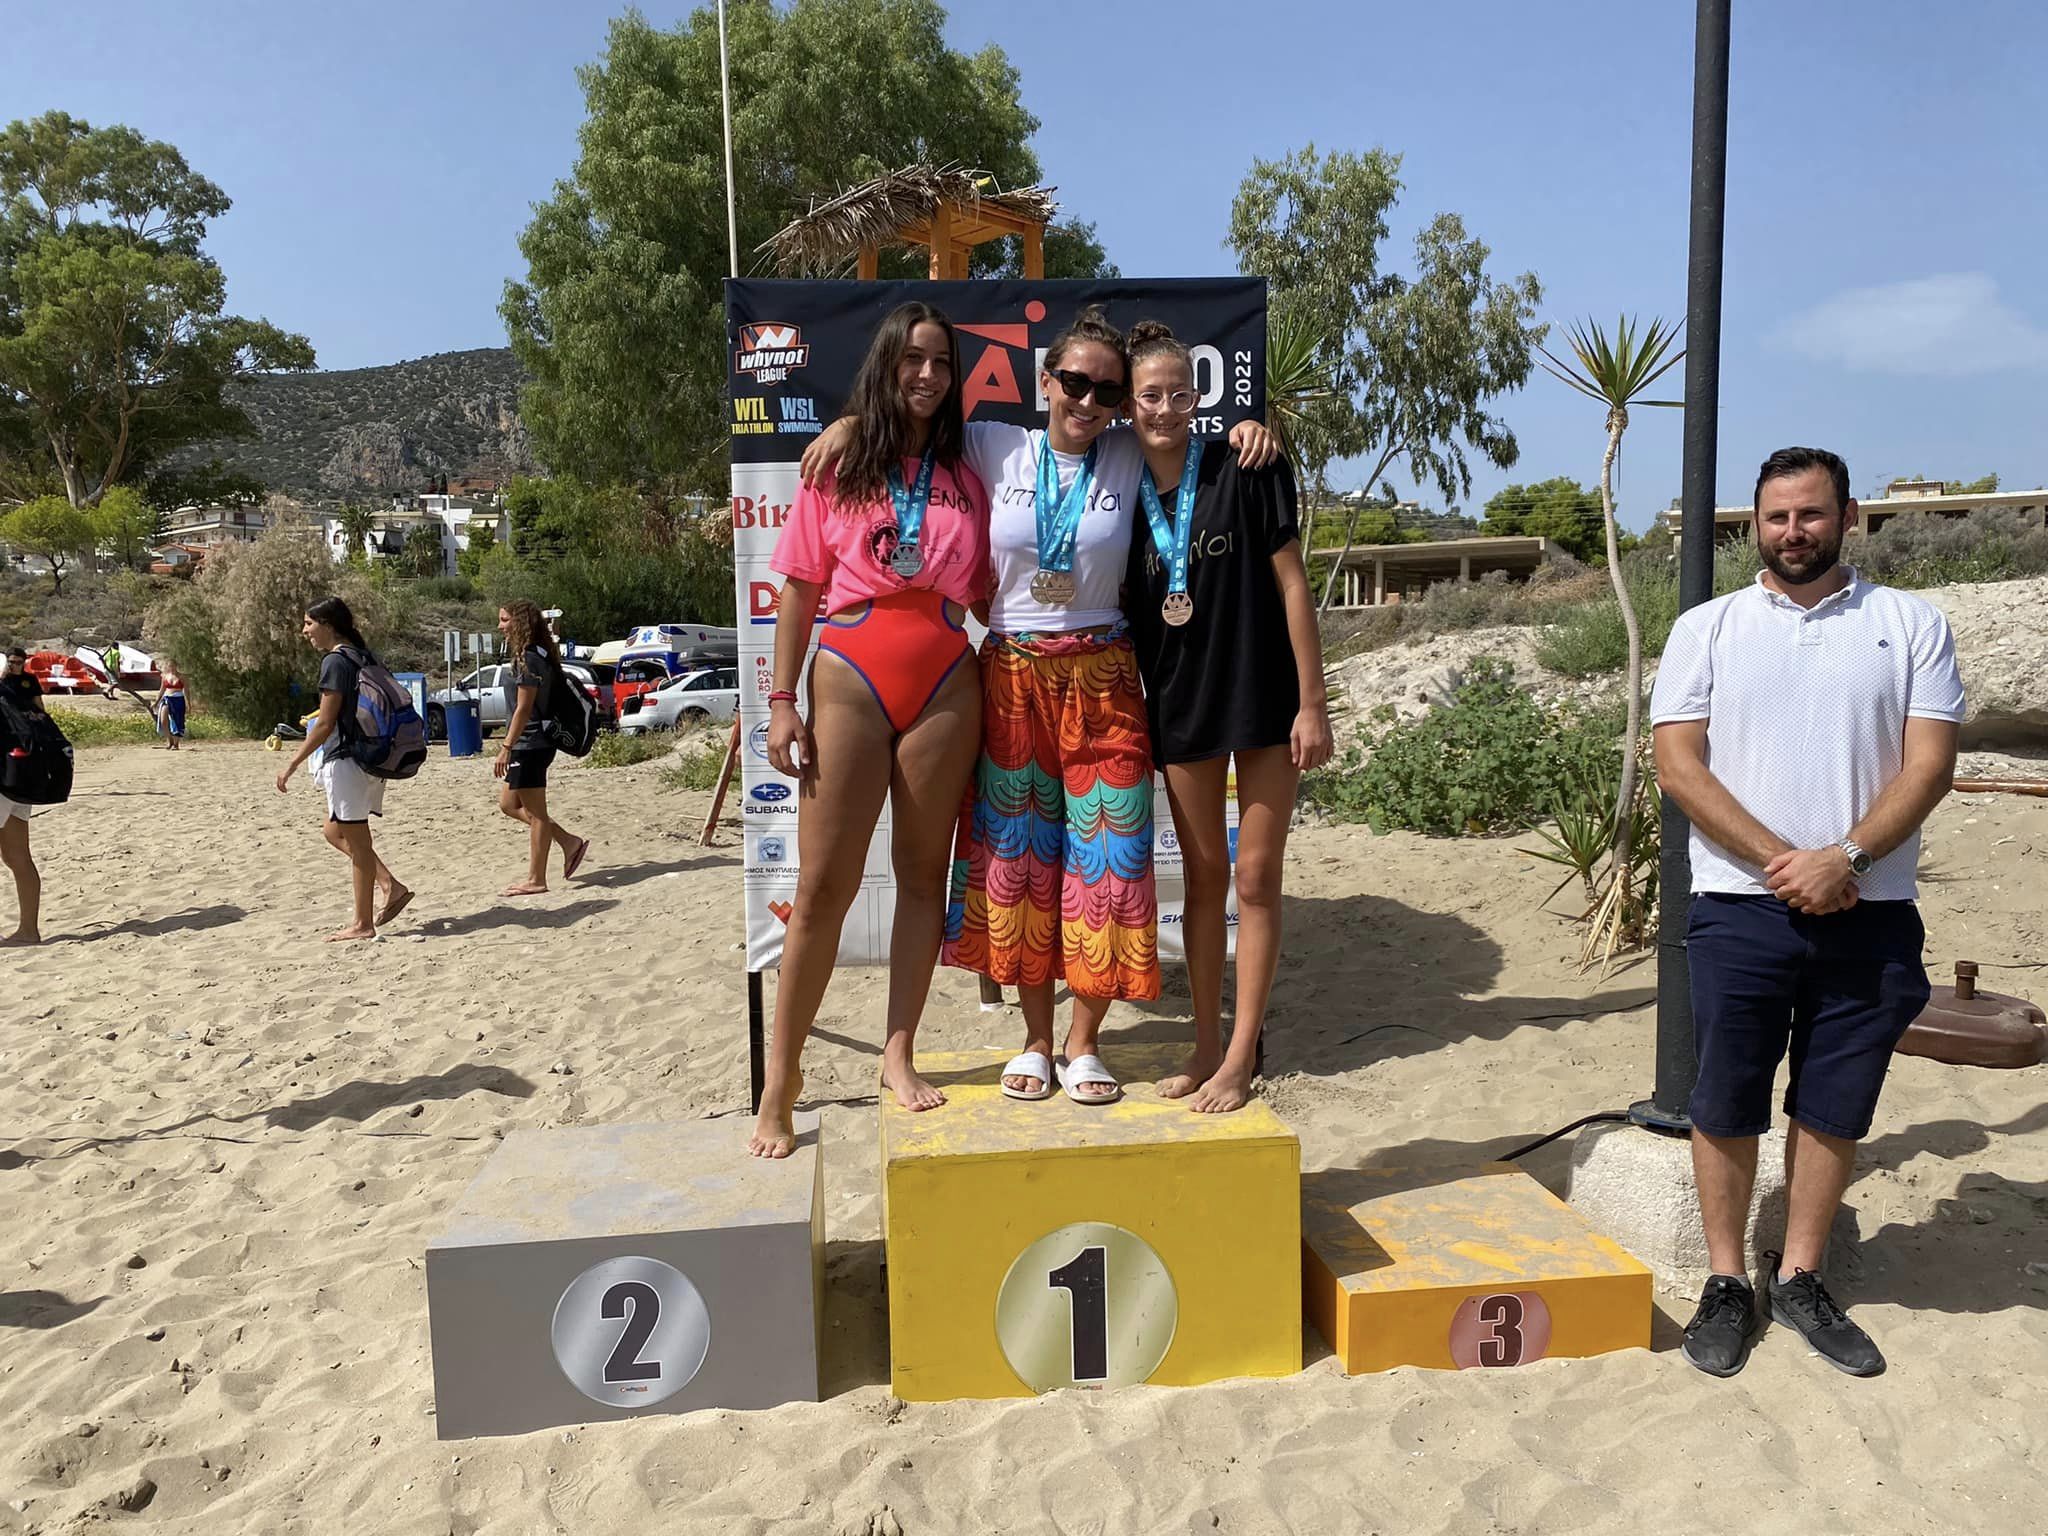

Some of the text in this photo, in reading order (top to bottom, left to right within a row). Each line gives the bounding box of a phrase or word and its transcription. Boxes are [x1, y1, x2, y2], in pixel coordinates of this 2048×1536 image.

[740, 349, 804, 369] whynot
[756, 367, 787, 384] LEAGUE
[1234, 350, 1252, 407] 2022
[734, 397, 819, 421] WTL WSL
[731, 422, 823, 435] TRIATHLON SWIMMING
[758, 684, 771, 692] RO
[745, 806, 797, 814] SUBARU
[1048, 1246, 1108, 1383] 1
[600, 1280, 663, 1384] 2
[1478, 1293, 1524, 1368] 3
